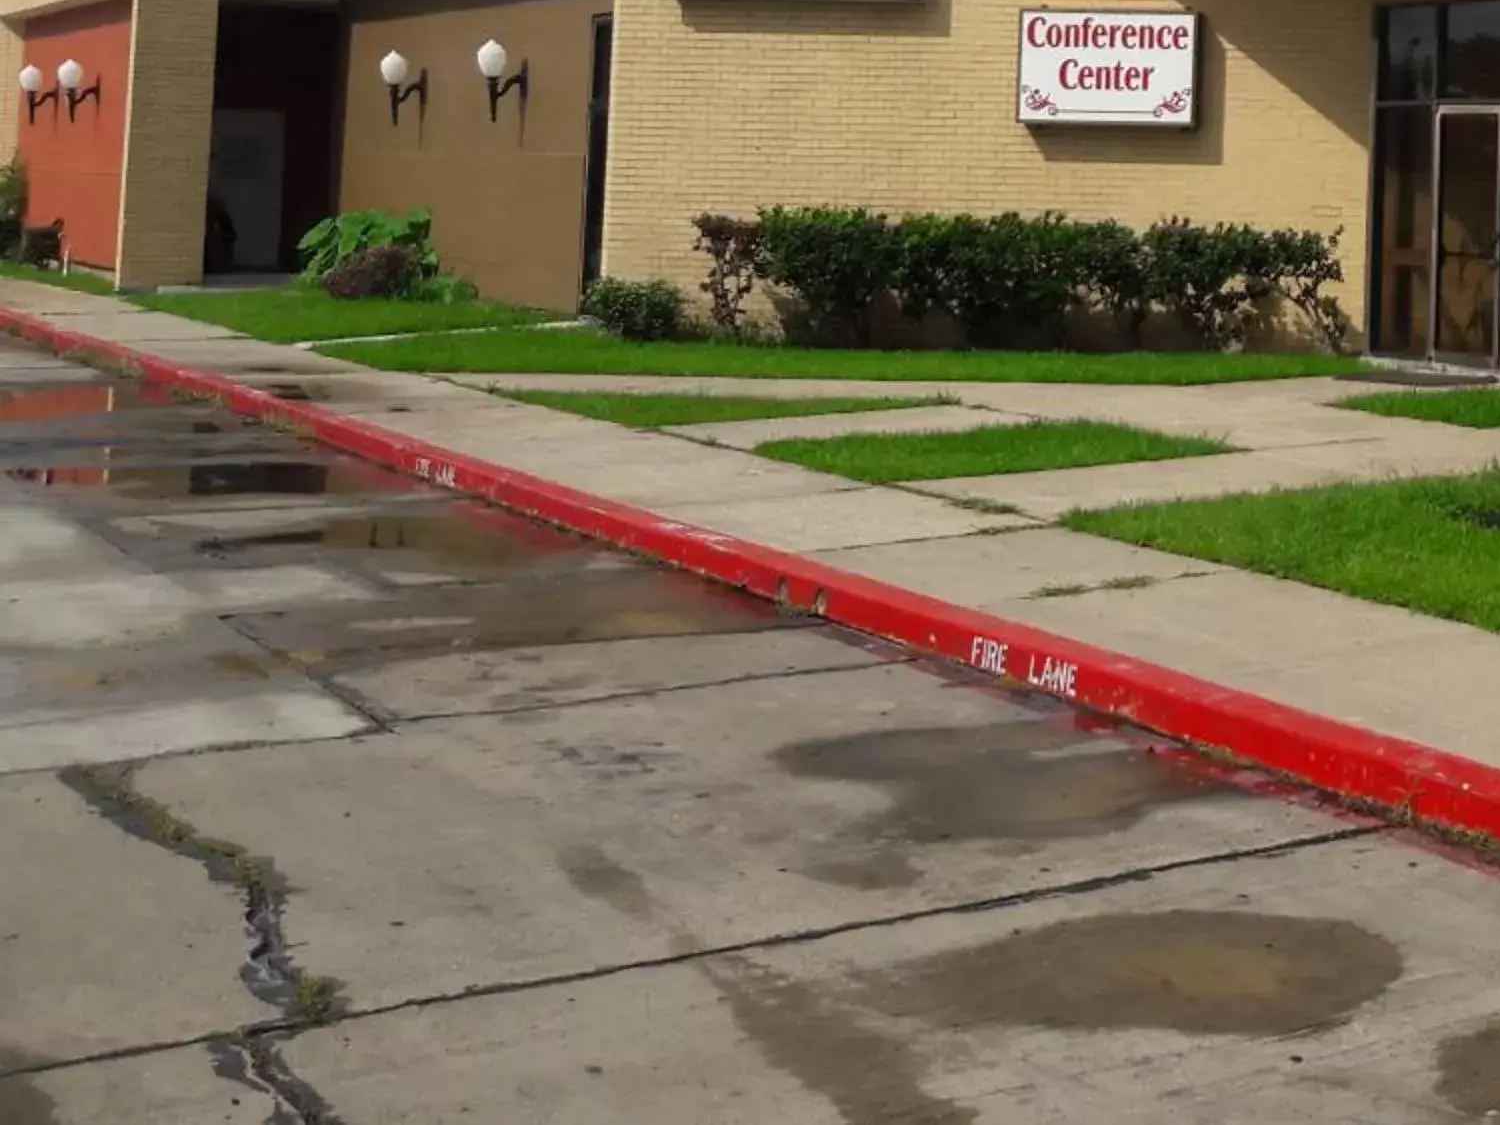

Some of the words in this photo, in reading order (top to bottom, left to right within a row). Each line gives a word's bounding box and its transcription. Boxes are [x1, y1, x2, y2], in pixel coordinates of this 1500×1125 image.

[1027, 16, 1189, 50] Conference
[1059, 58, 1155, 91] Center
[970, 635, 1009, 674] FIRE
[1028, 652, 1078, 698] LANE
